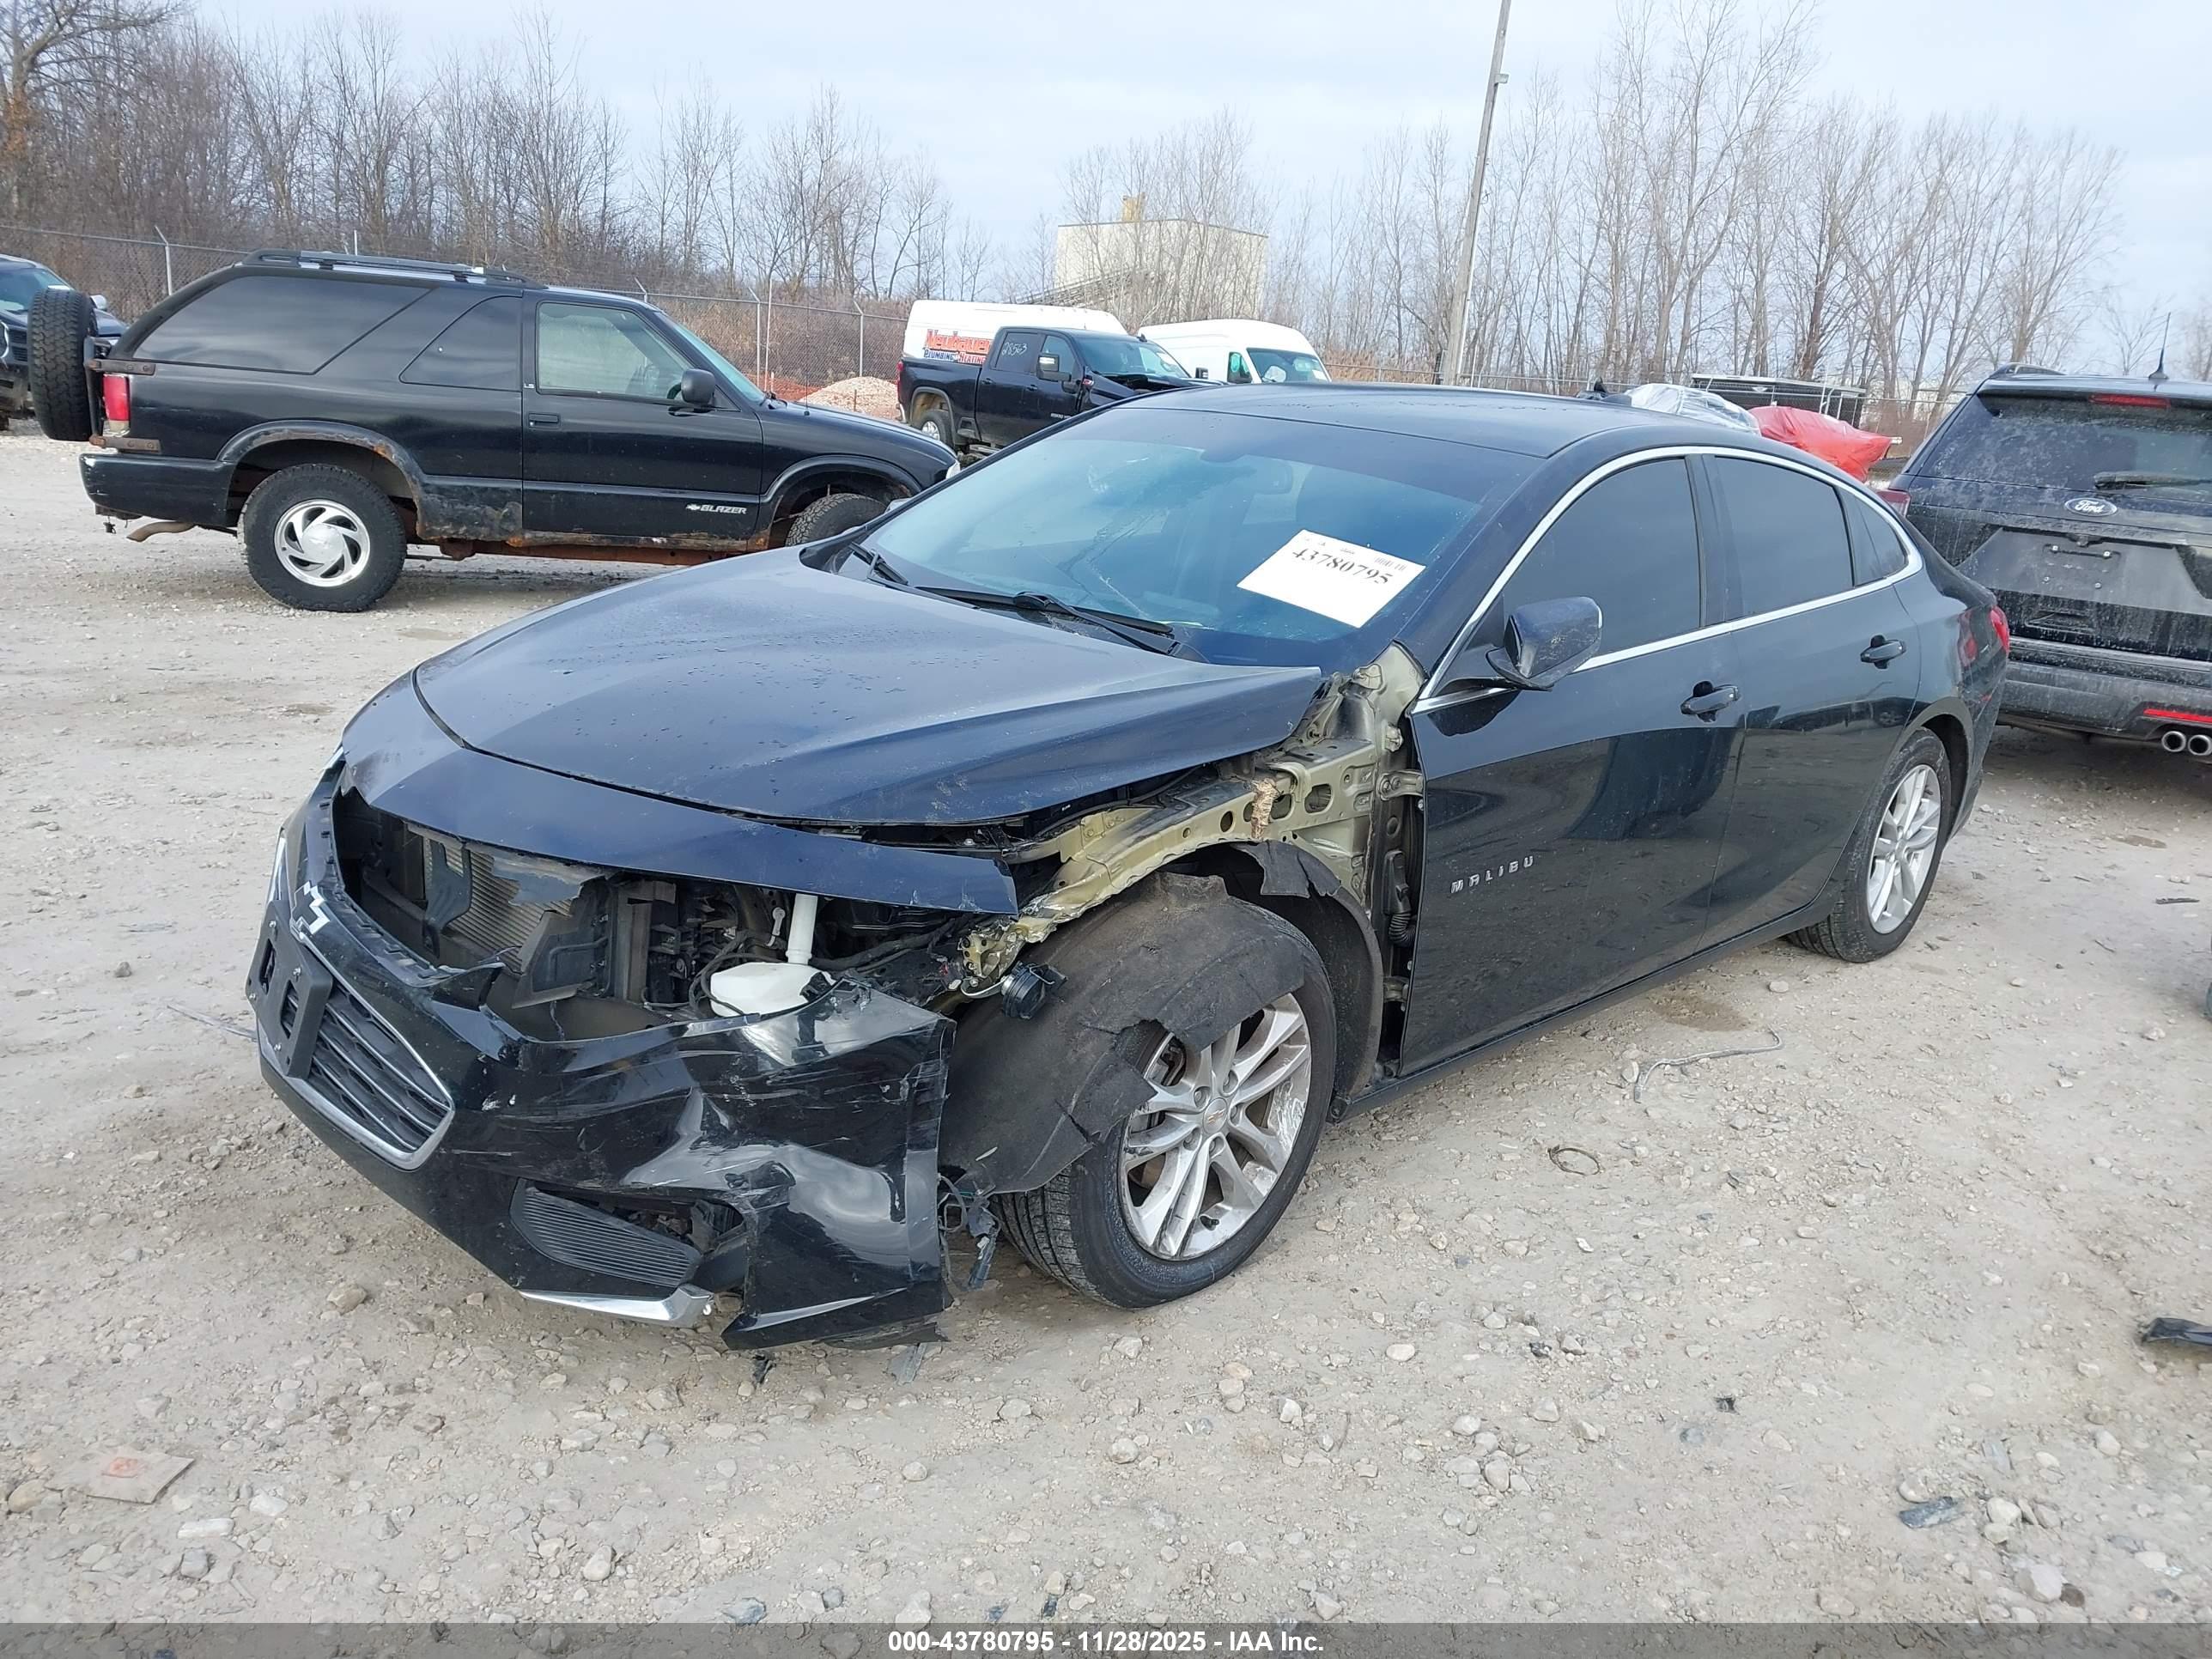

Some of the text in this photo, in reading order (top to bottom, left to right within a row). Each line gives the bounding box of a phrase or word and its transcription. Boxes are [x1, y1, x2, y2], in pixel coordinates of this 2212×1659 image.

[700, 504, 748, 515] BLAZER
[2074, 500, 2106, 514] Ford
[1291, 548, 1394, 585] 43780795
[1450, 855, 1534, 894] MALIBU
